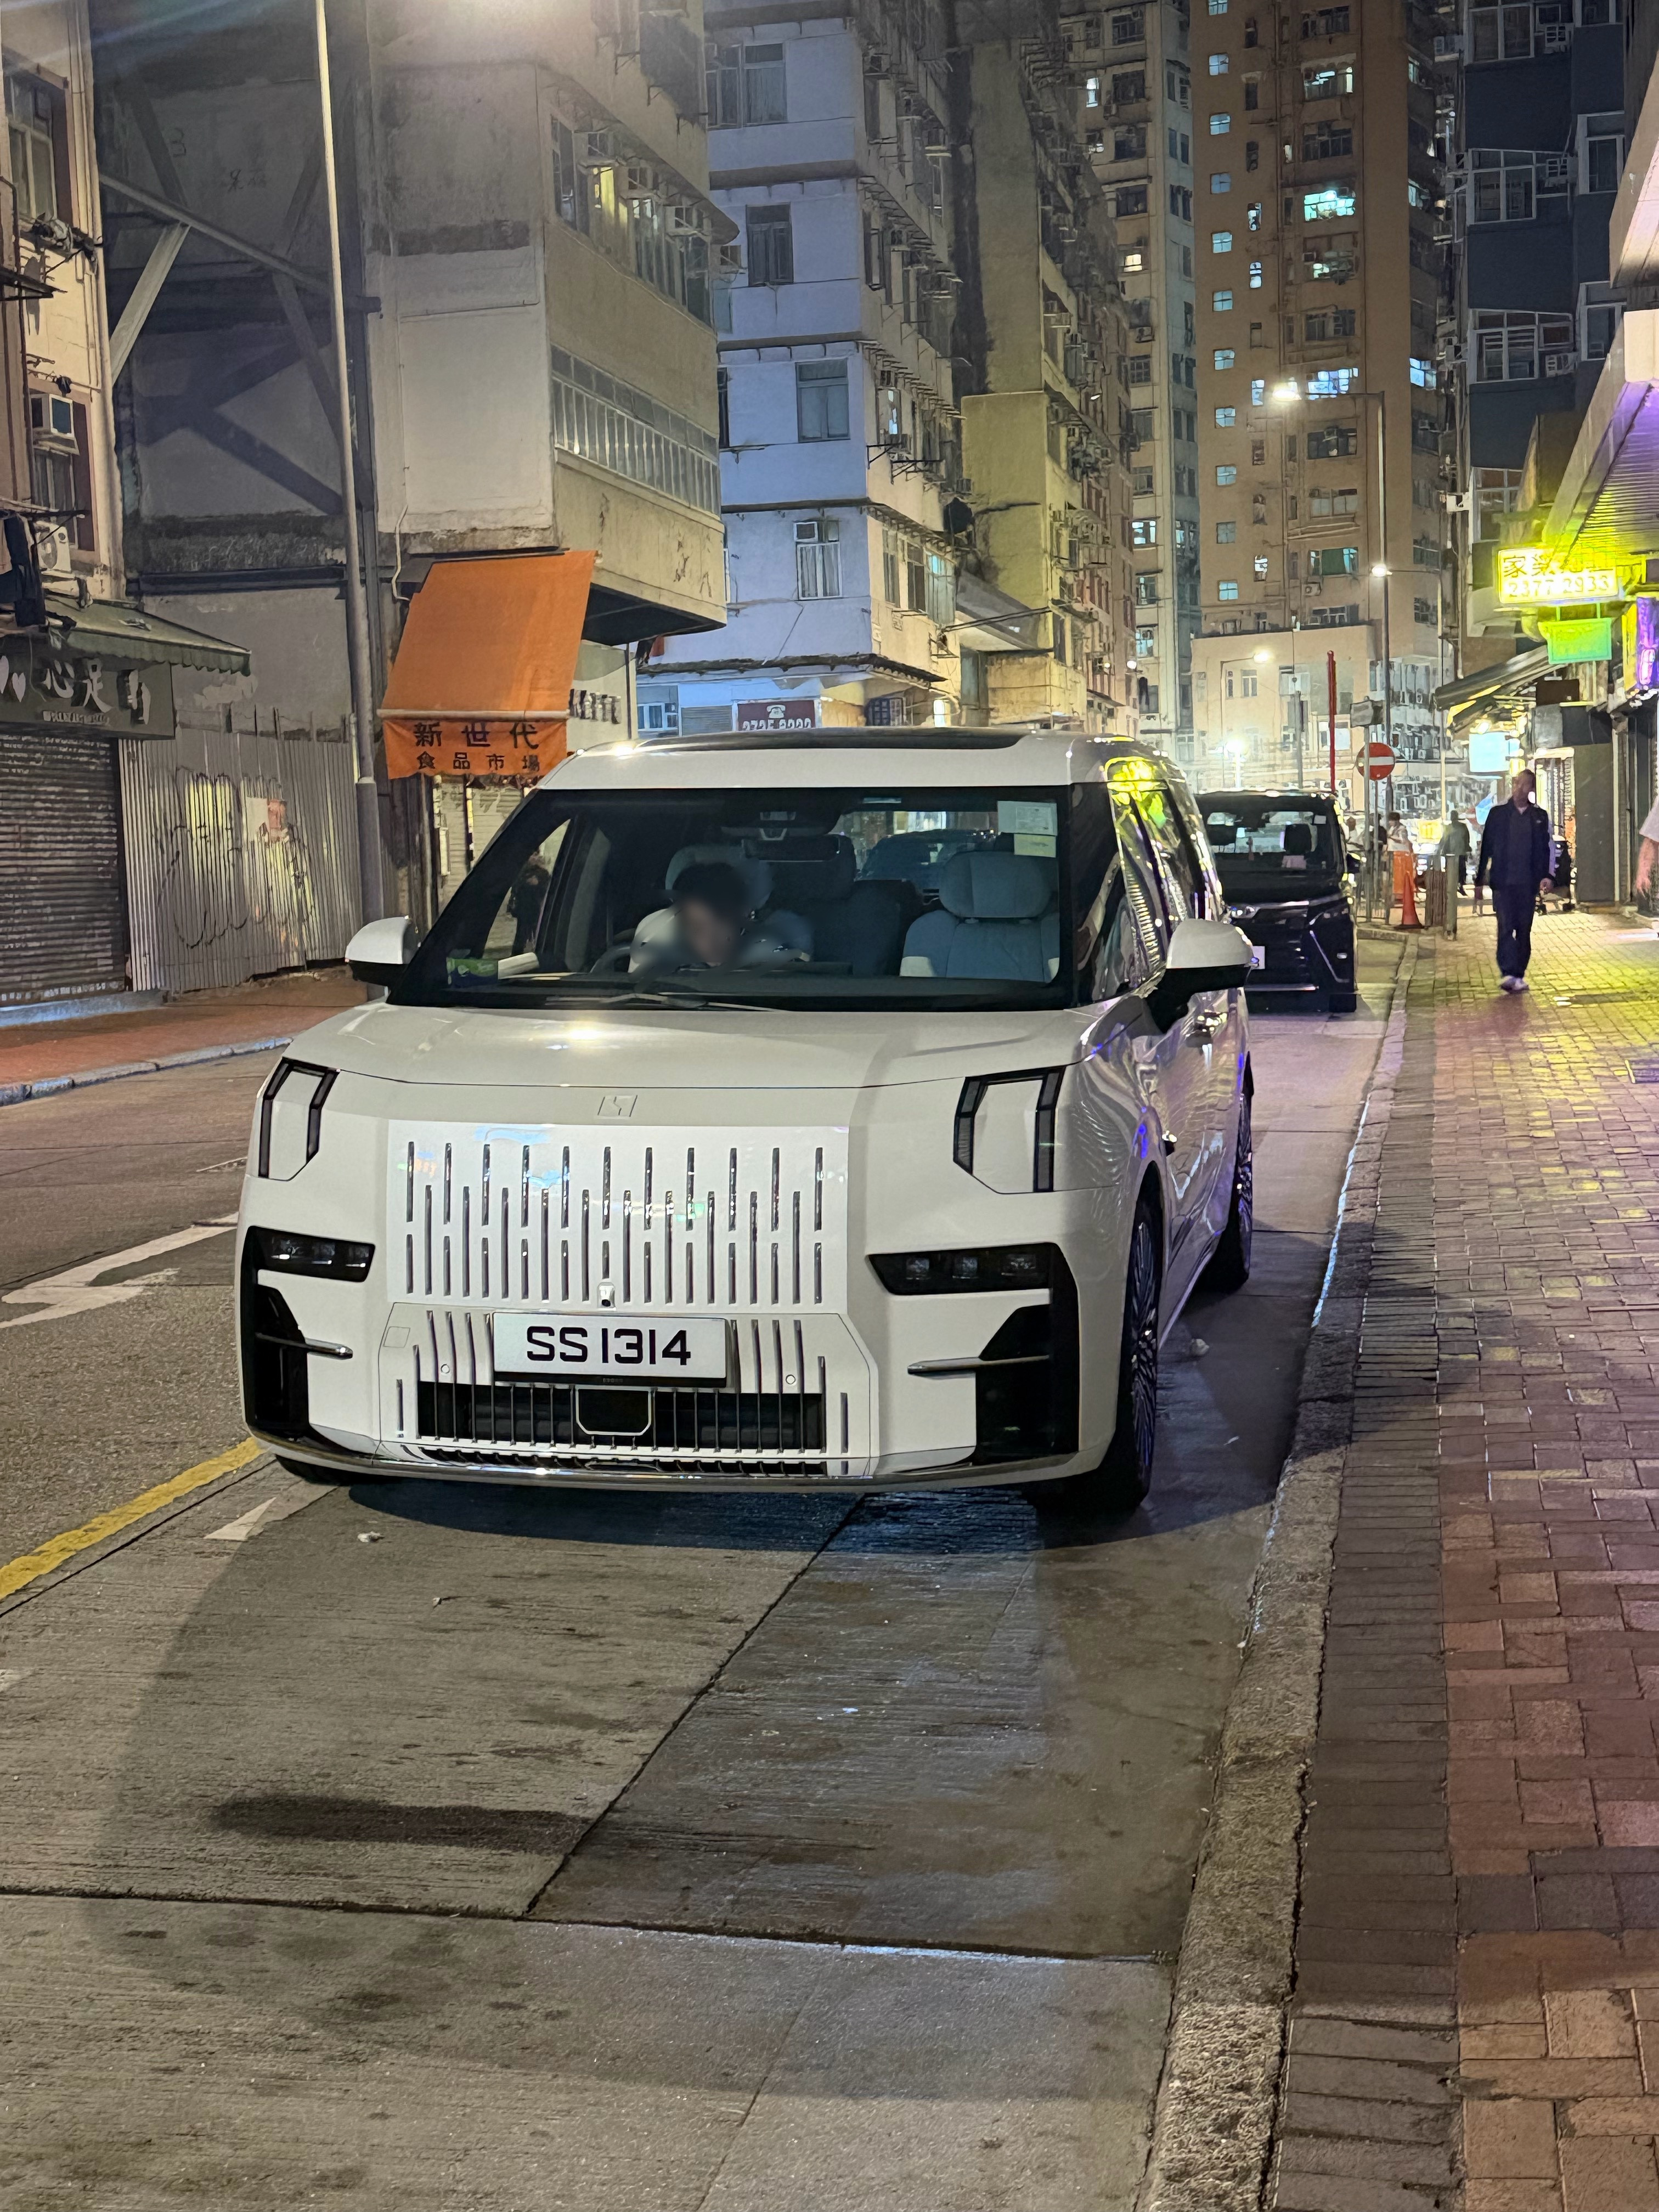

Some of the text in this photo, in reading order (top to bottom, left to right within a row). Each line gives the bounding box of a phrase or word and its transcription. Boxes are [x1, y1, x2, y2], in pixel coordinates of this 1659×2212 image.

[413, 721, 540, 749] 新世代
[416, 751, 540, 772] 食品市場
[527, 1325, 691, 1366] SS 1314
